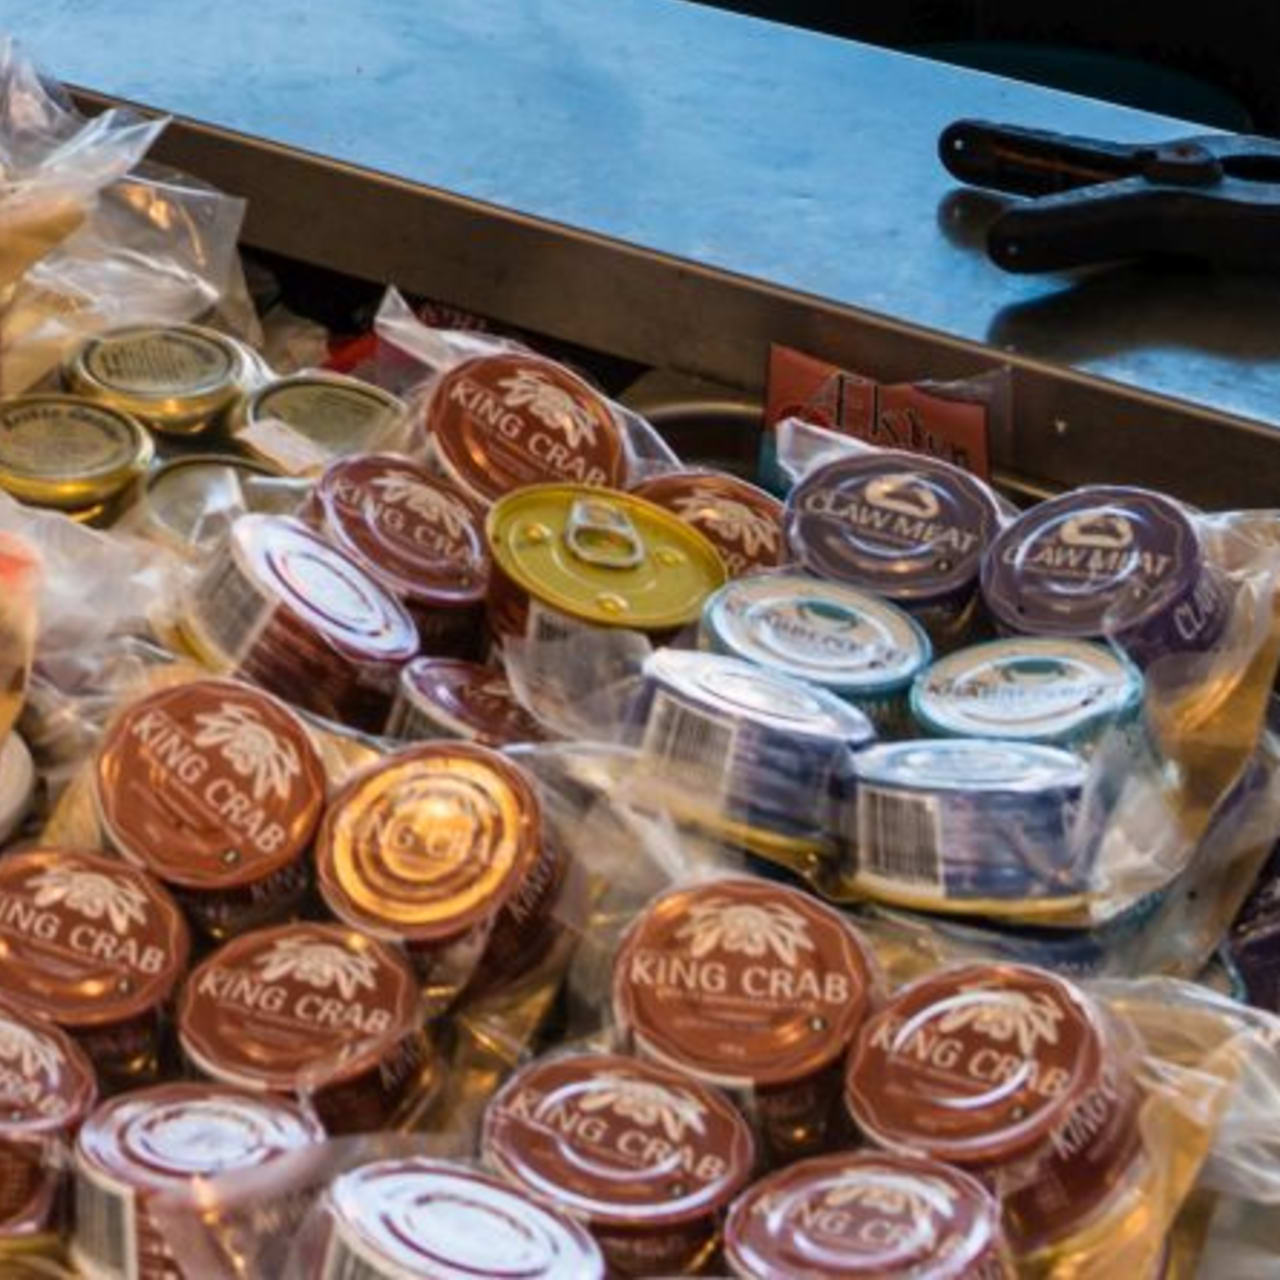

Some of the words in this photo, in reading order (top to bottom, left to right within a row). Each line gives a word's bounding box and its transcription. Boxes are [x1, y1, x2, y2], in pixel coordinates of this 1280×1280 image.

[450, 380, 525, 438] KING
[527, 432, 608, 489] CRAB
[804, 487, 894, 530] CLAW
[892, 514, 979, 554] MEAT
[131, 707, 209, 784] KING
[204, 777, 287, 853] CRAB
[69, 925, 166, 976] CRAB
[629, 955, 723, 994] KING
[740, 962, 850, 1004] CRAB
[197, 968, 288, 1011] KING
[294, 986, 393, 1034] CRAB
[869, 1012, 964, 1069] KING
[966, 1045, 1071, 1097] CRAB
[615, 1127, 727, 1184] CRAB
